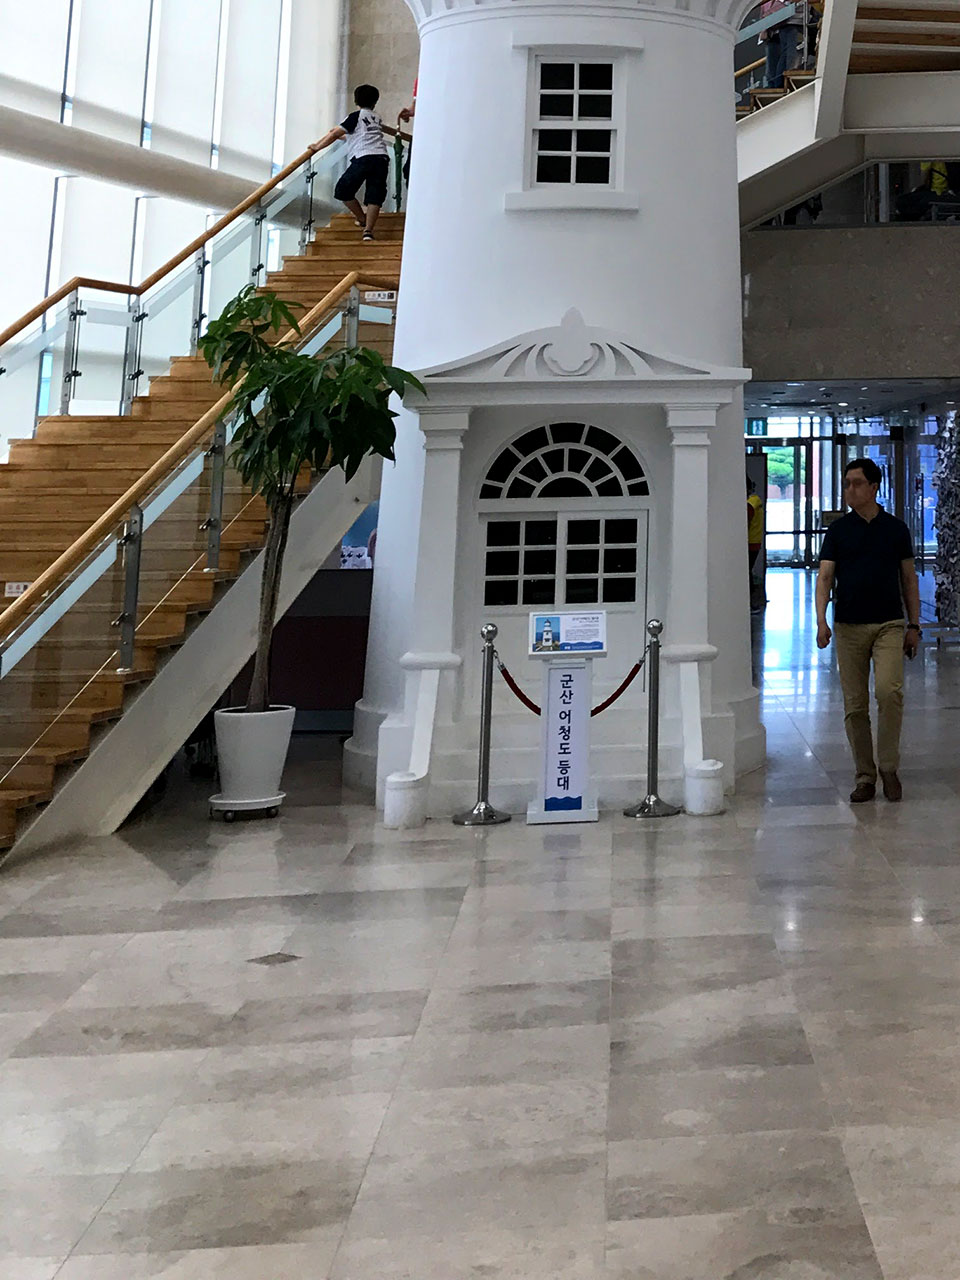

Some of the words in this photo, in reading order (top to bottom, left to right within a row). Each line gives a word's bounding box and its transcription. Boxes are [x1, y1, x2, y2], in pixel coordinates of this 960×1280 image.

[560, 674, 574, 705] 군산
[558, 709, 572, 755] 어청도
[557, 760, 571, 791] 등대
